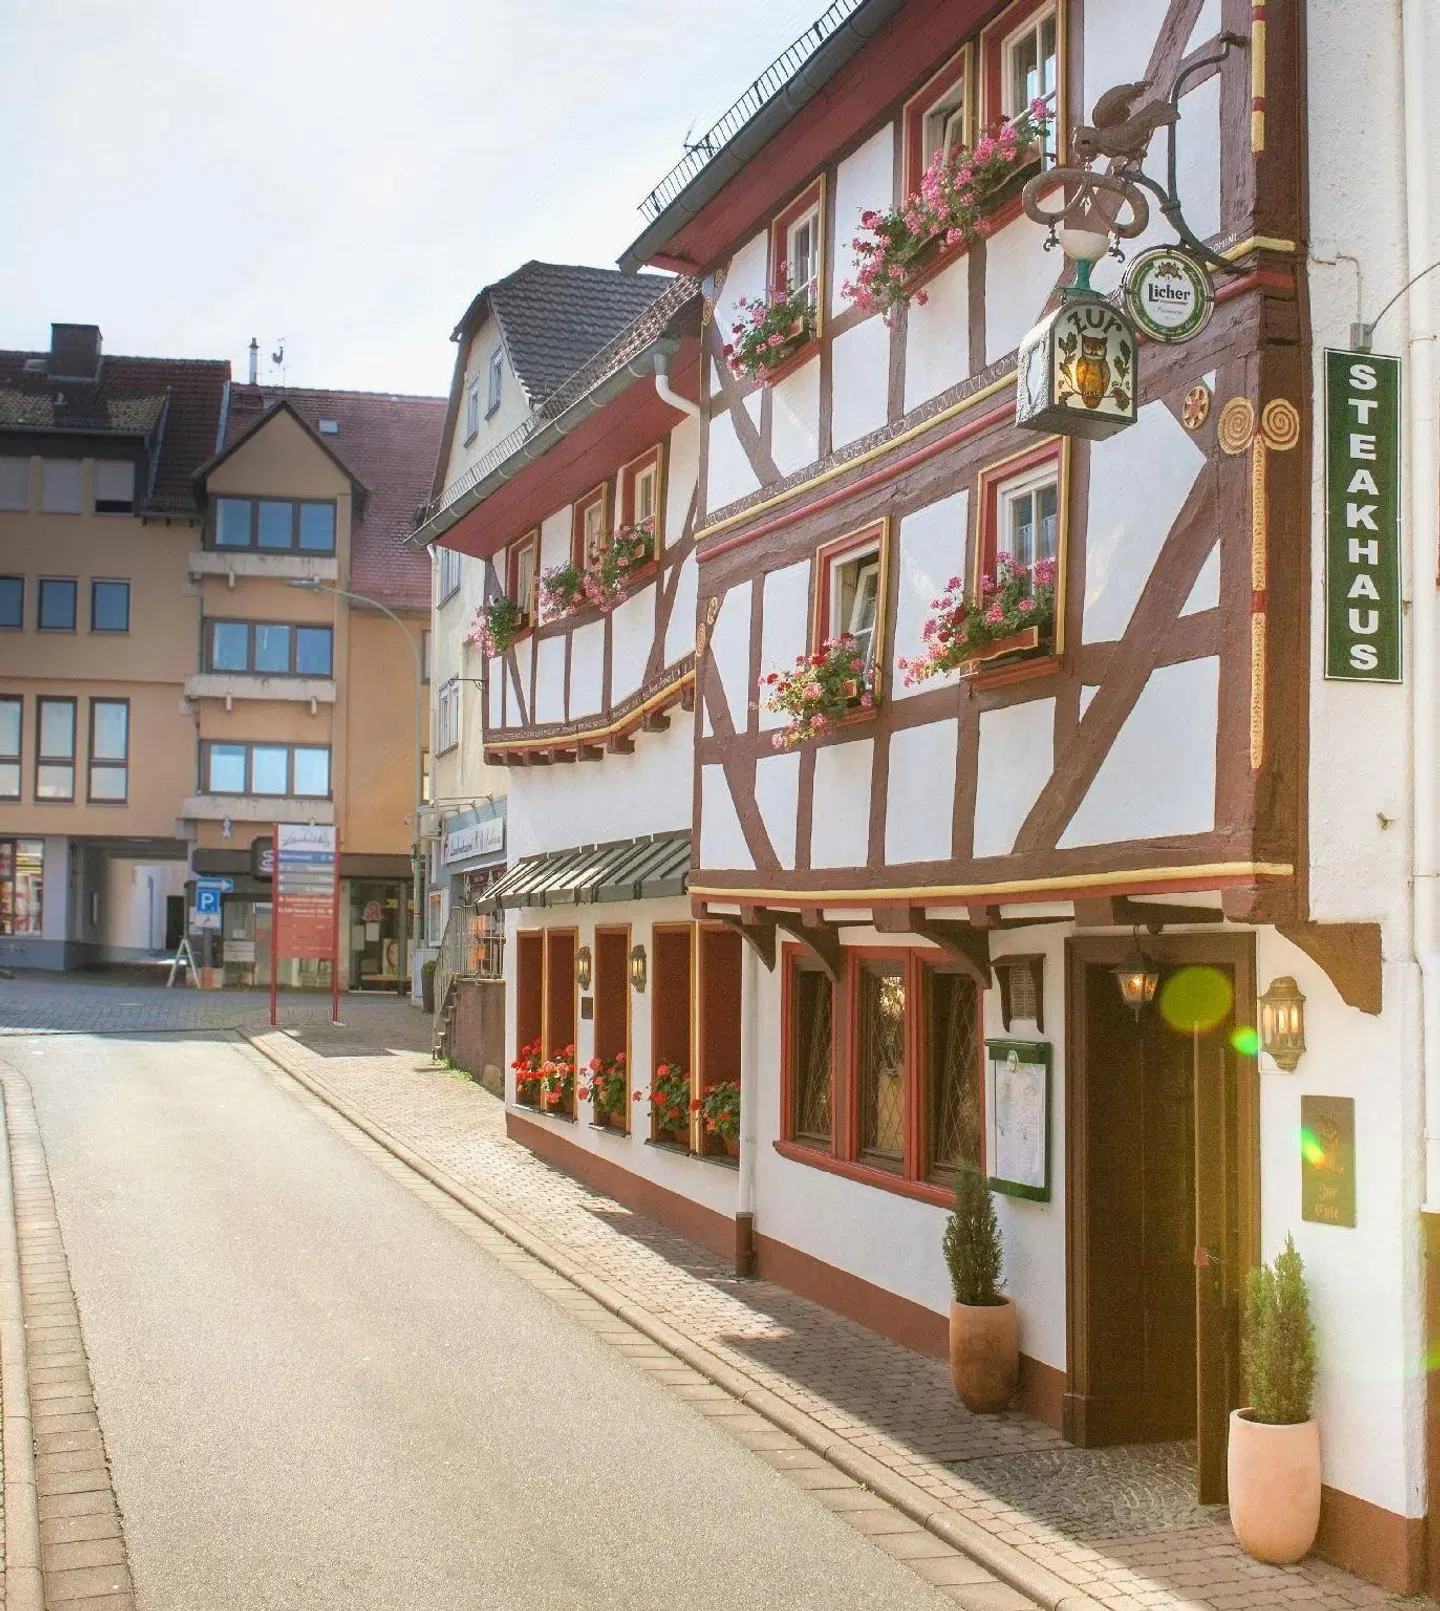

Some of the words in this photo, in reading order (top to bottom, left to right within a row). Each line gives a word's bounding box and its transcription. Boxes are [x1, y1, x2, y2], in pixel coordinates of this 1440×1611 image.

[1148, 283, 1191, 302] Licher
[1346, 364, 1379, 669] STEAKHAUS
[202, 892, 214, 909] P
